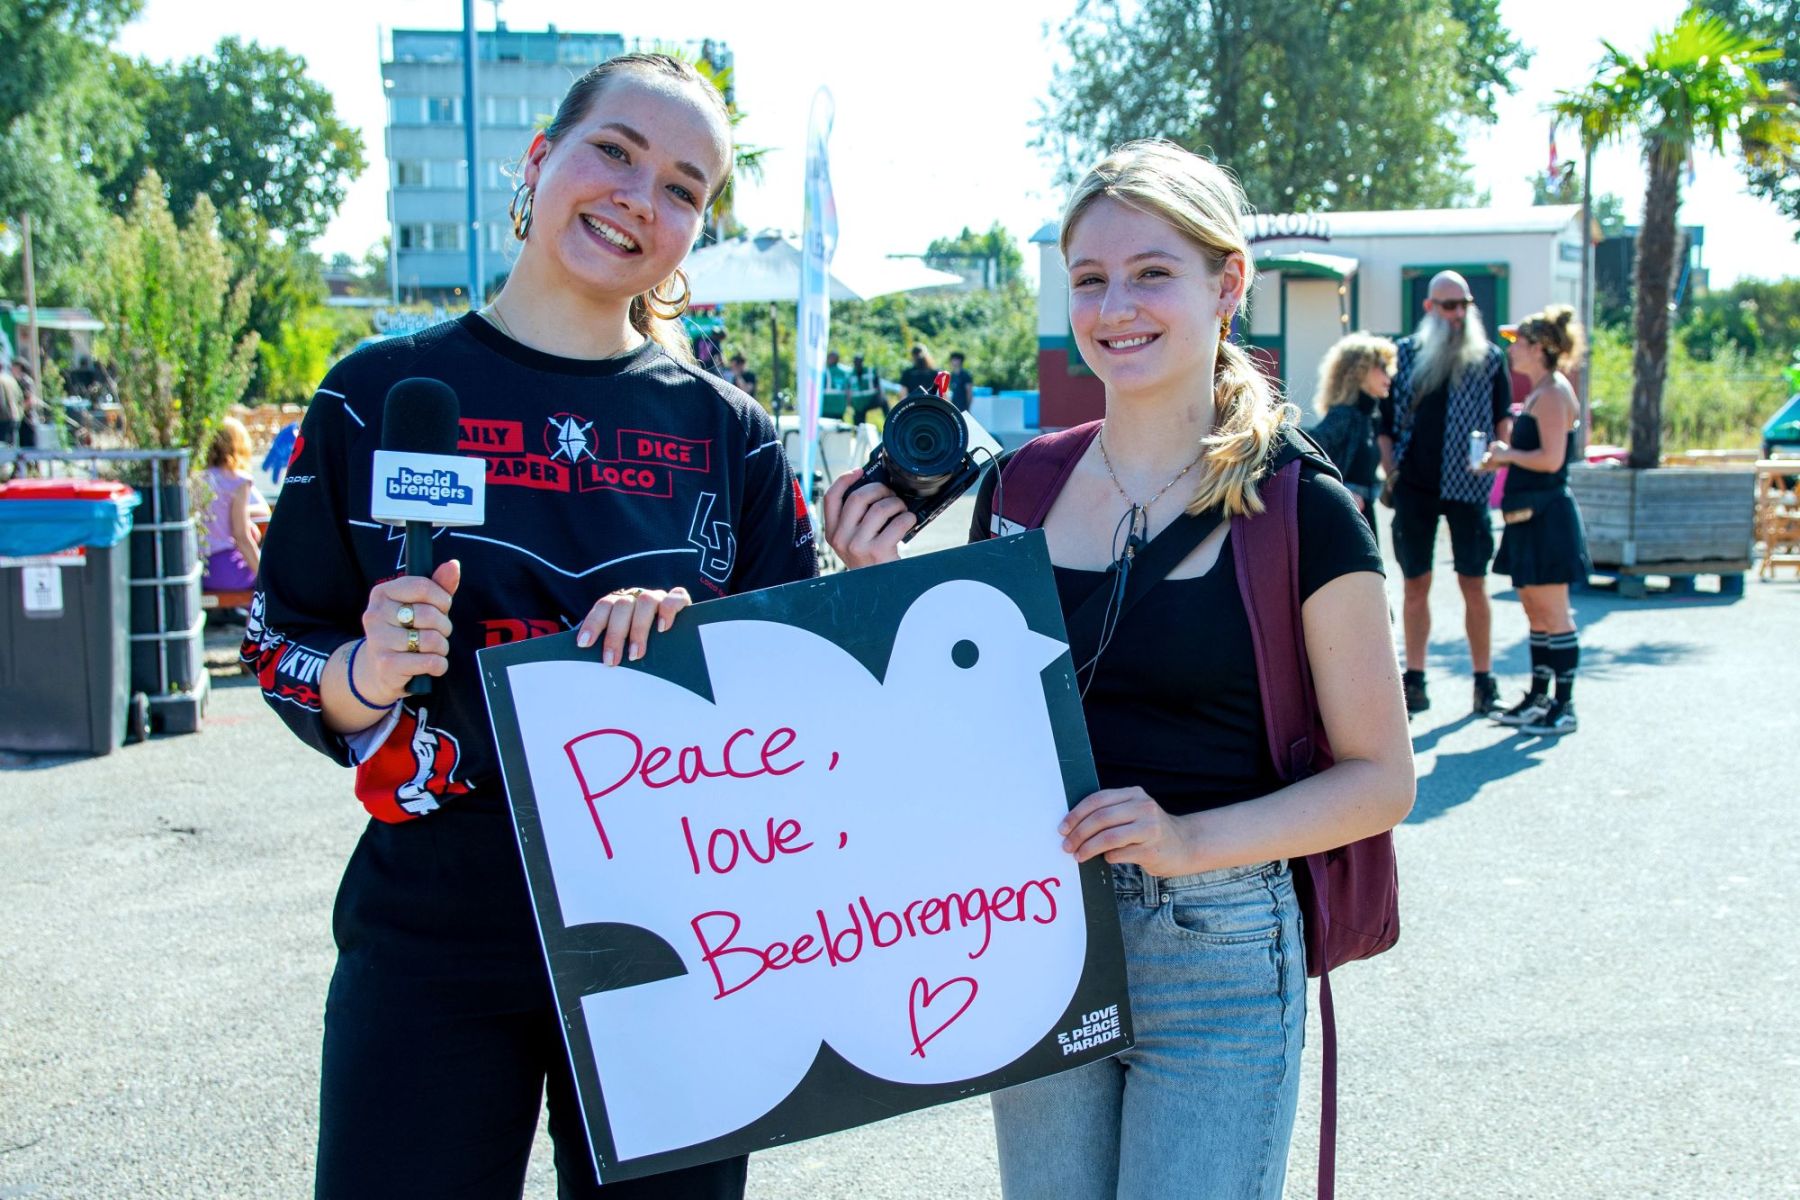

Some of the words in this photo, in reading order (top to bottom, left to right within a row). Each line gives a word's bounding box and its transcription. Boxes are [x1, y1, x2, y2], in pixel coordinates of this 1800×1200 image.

[459, 424, 511, 446] AILY
[637, 438, 695, 463] DICE
[400, 469, 452, 487] beeld
[591, 464, 656, 489] LOCO
[388, 479, 466, 501] brengers
[563, 726, 840, 859] Peace,
[681, 815, 849, 875] love,
[690, 877, 1062, 1001] Beeldbrengers
[1081, 1004, 1119, 1025] LOVE
[1072, 1015, 1120, 1040] PEACE
[1062, 1026, 1121, 1056] PARADE
